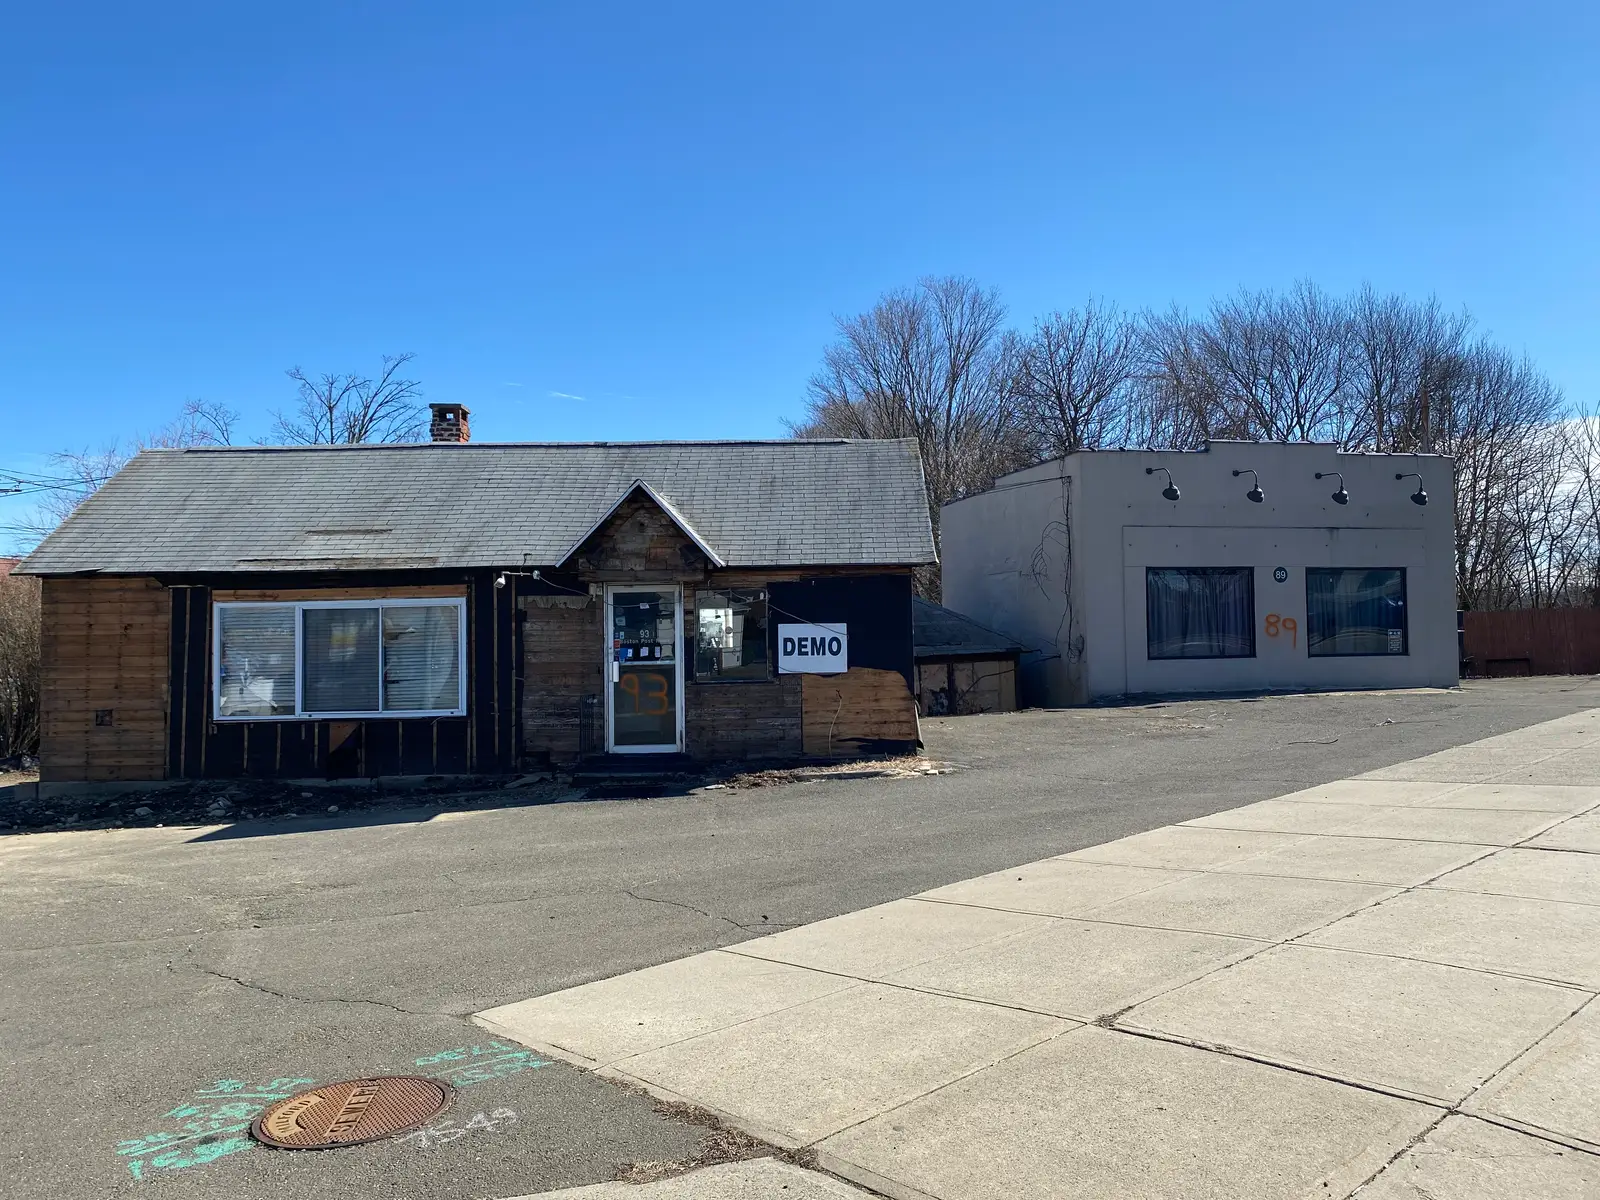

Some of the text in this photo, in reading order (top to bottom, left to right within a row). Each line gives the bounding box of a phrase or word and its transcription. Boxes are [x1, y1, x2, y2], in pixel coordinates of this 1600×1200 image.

[1275, 570, 1287, 580] 89
[639, 629, 650, 639] 93
[1264, 613, 1298, 650] 89
[782, 636, 842, 656] DEMO
[620, 672, 669, 715] 93
[329, 1085, 377, 1133] SEWER
